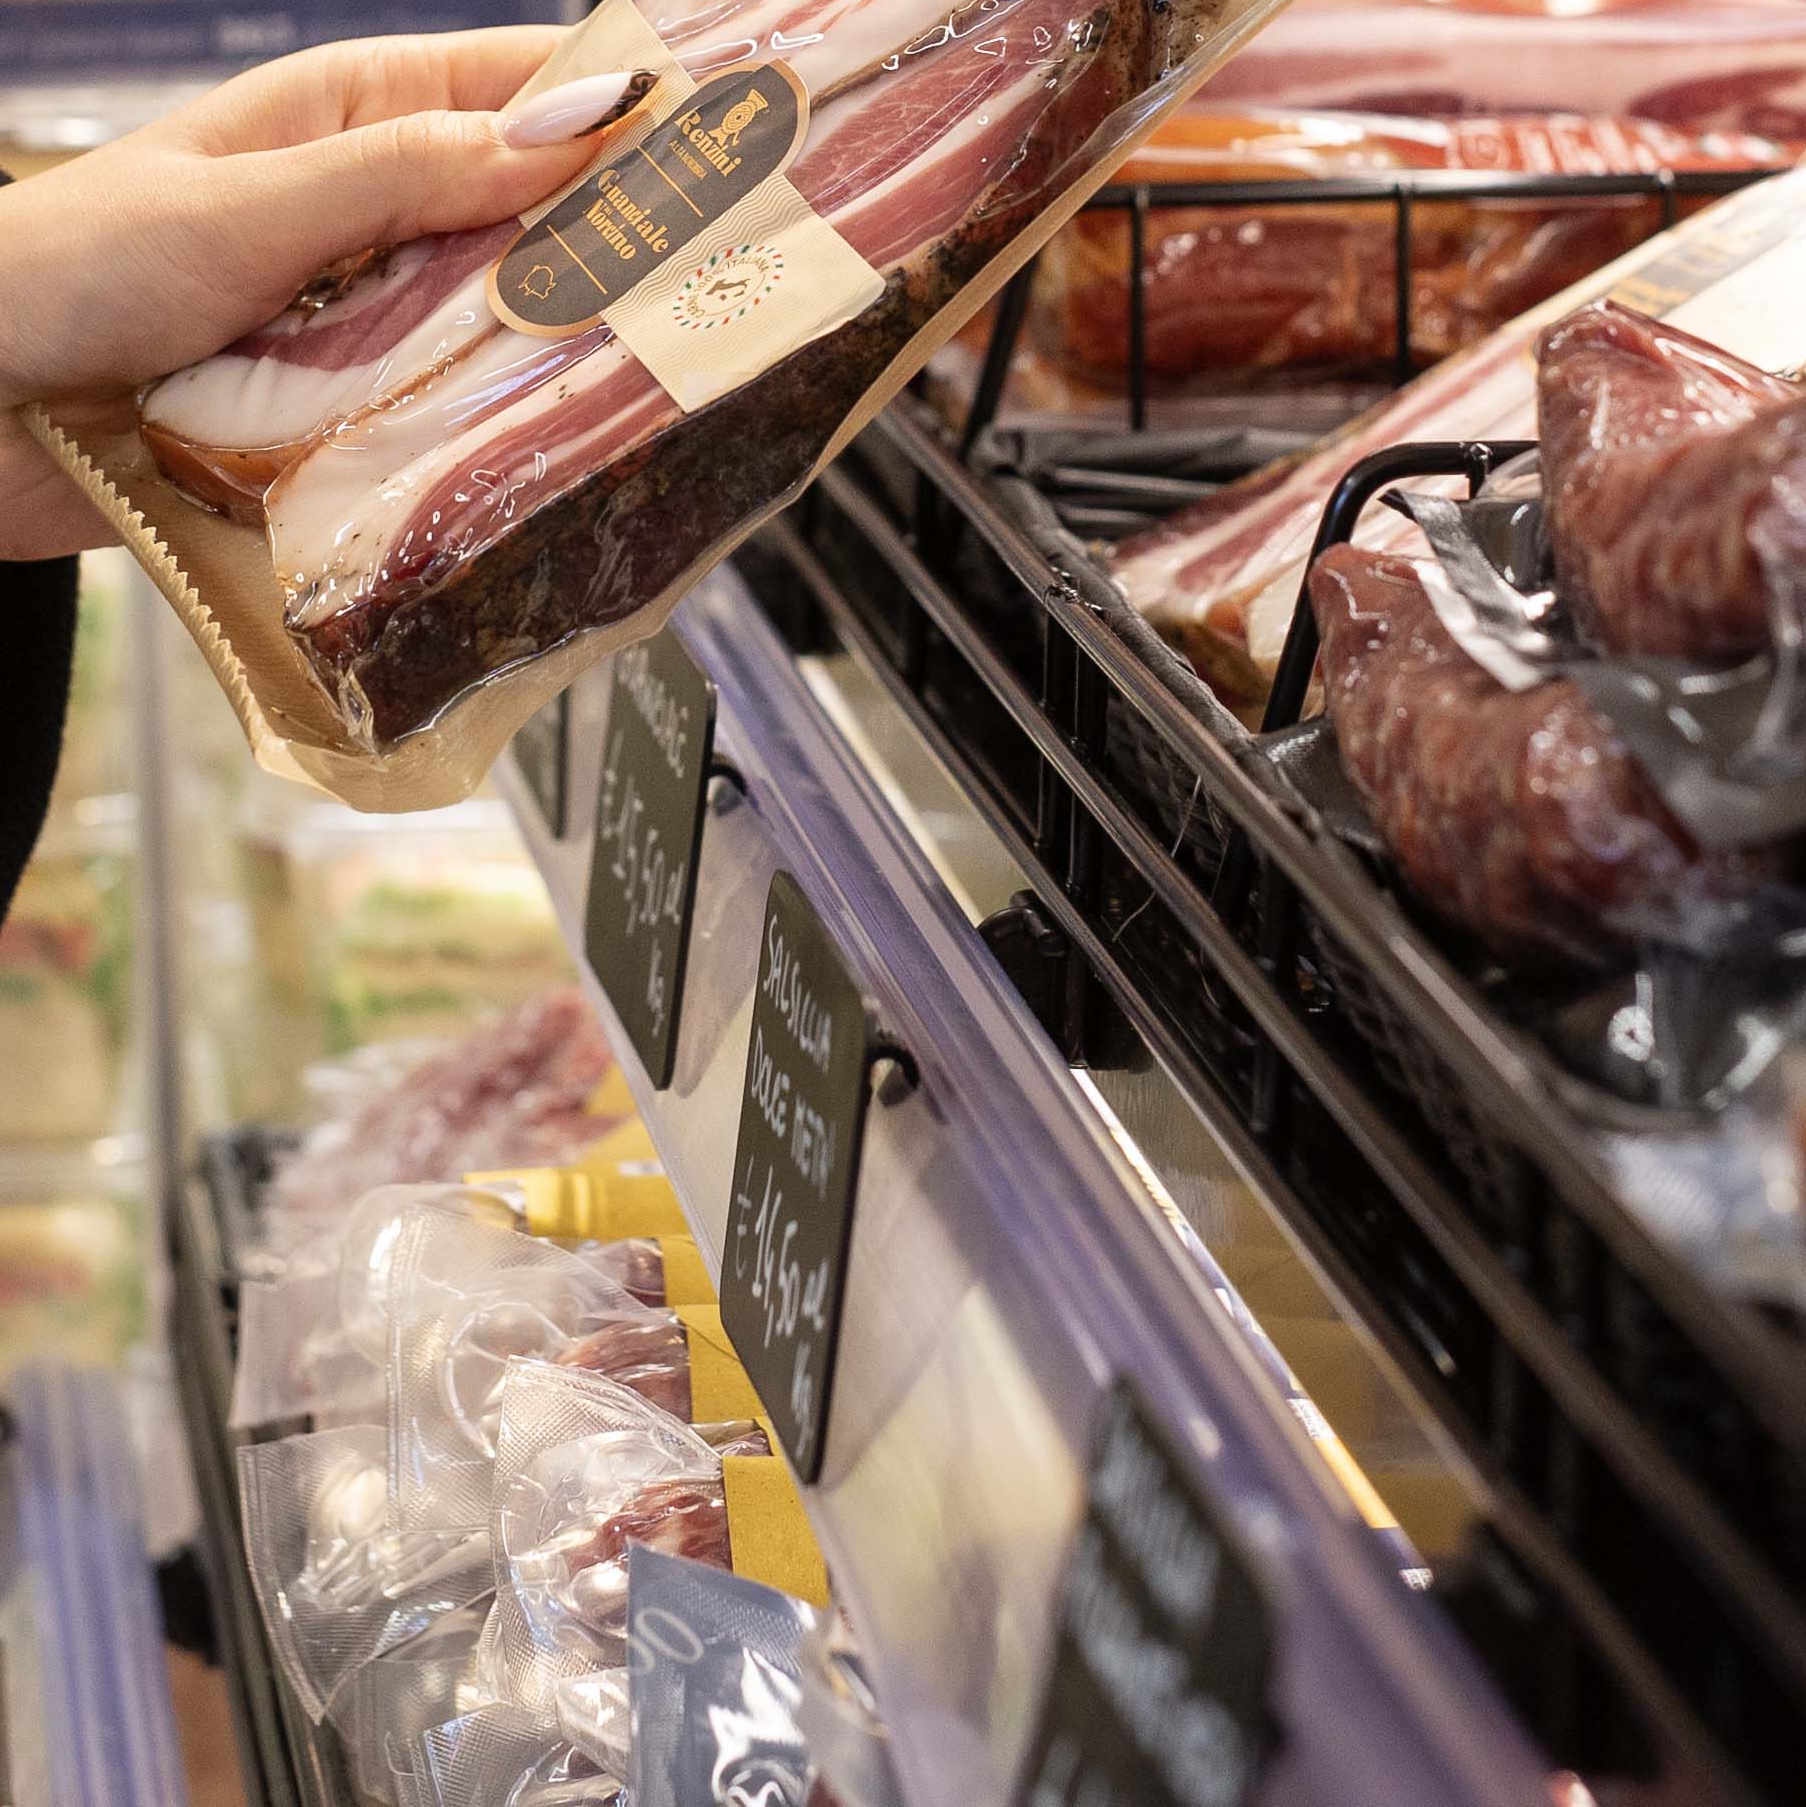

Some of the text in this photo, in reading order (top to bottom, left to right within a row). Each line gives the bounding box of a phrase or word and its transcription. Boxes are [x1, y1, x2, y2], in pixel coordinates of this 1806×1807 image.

[674, 109, 742, 178] Renzini
[582, 197, 636, 260] Norcino
[597, 168, 669, 253] Guanciale
